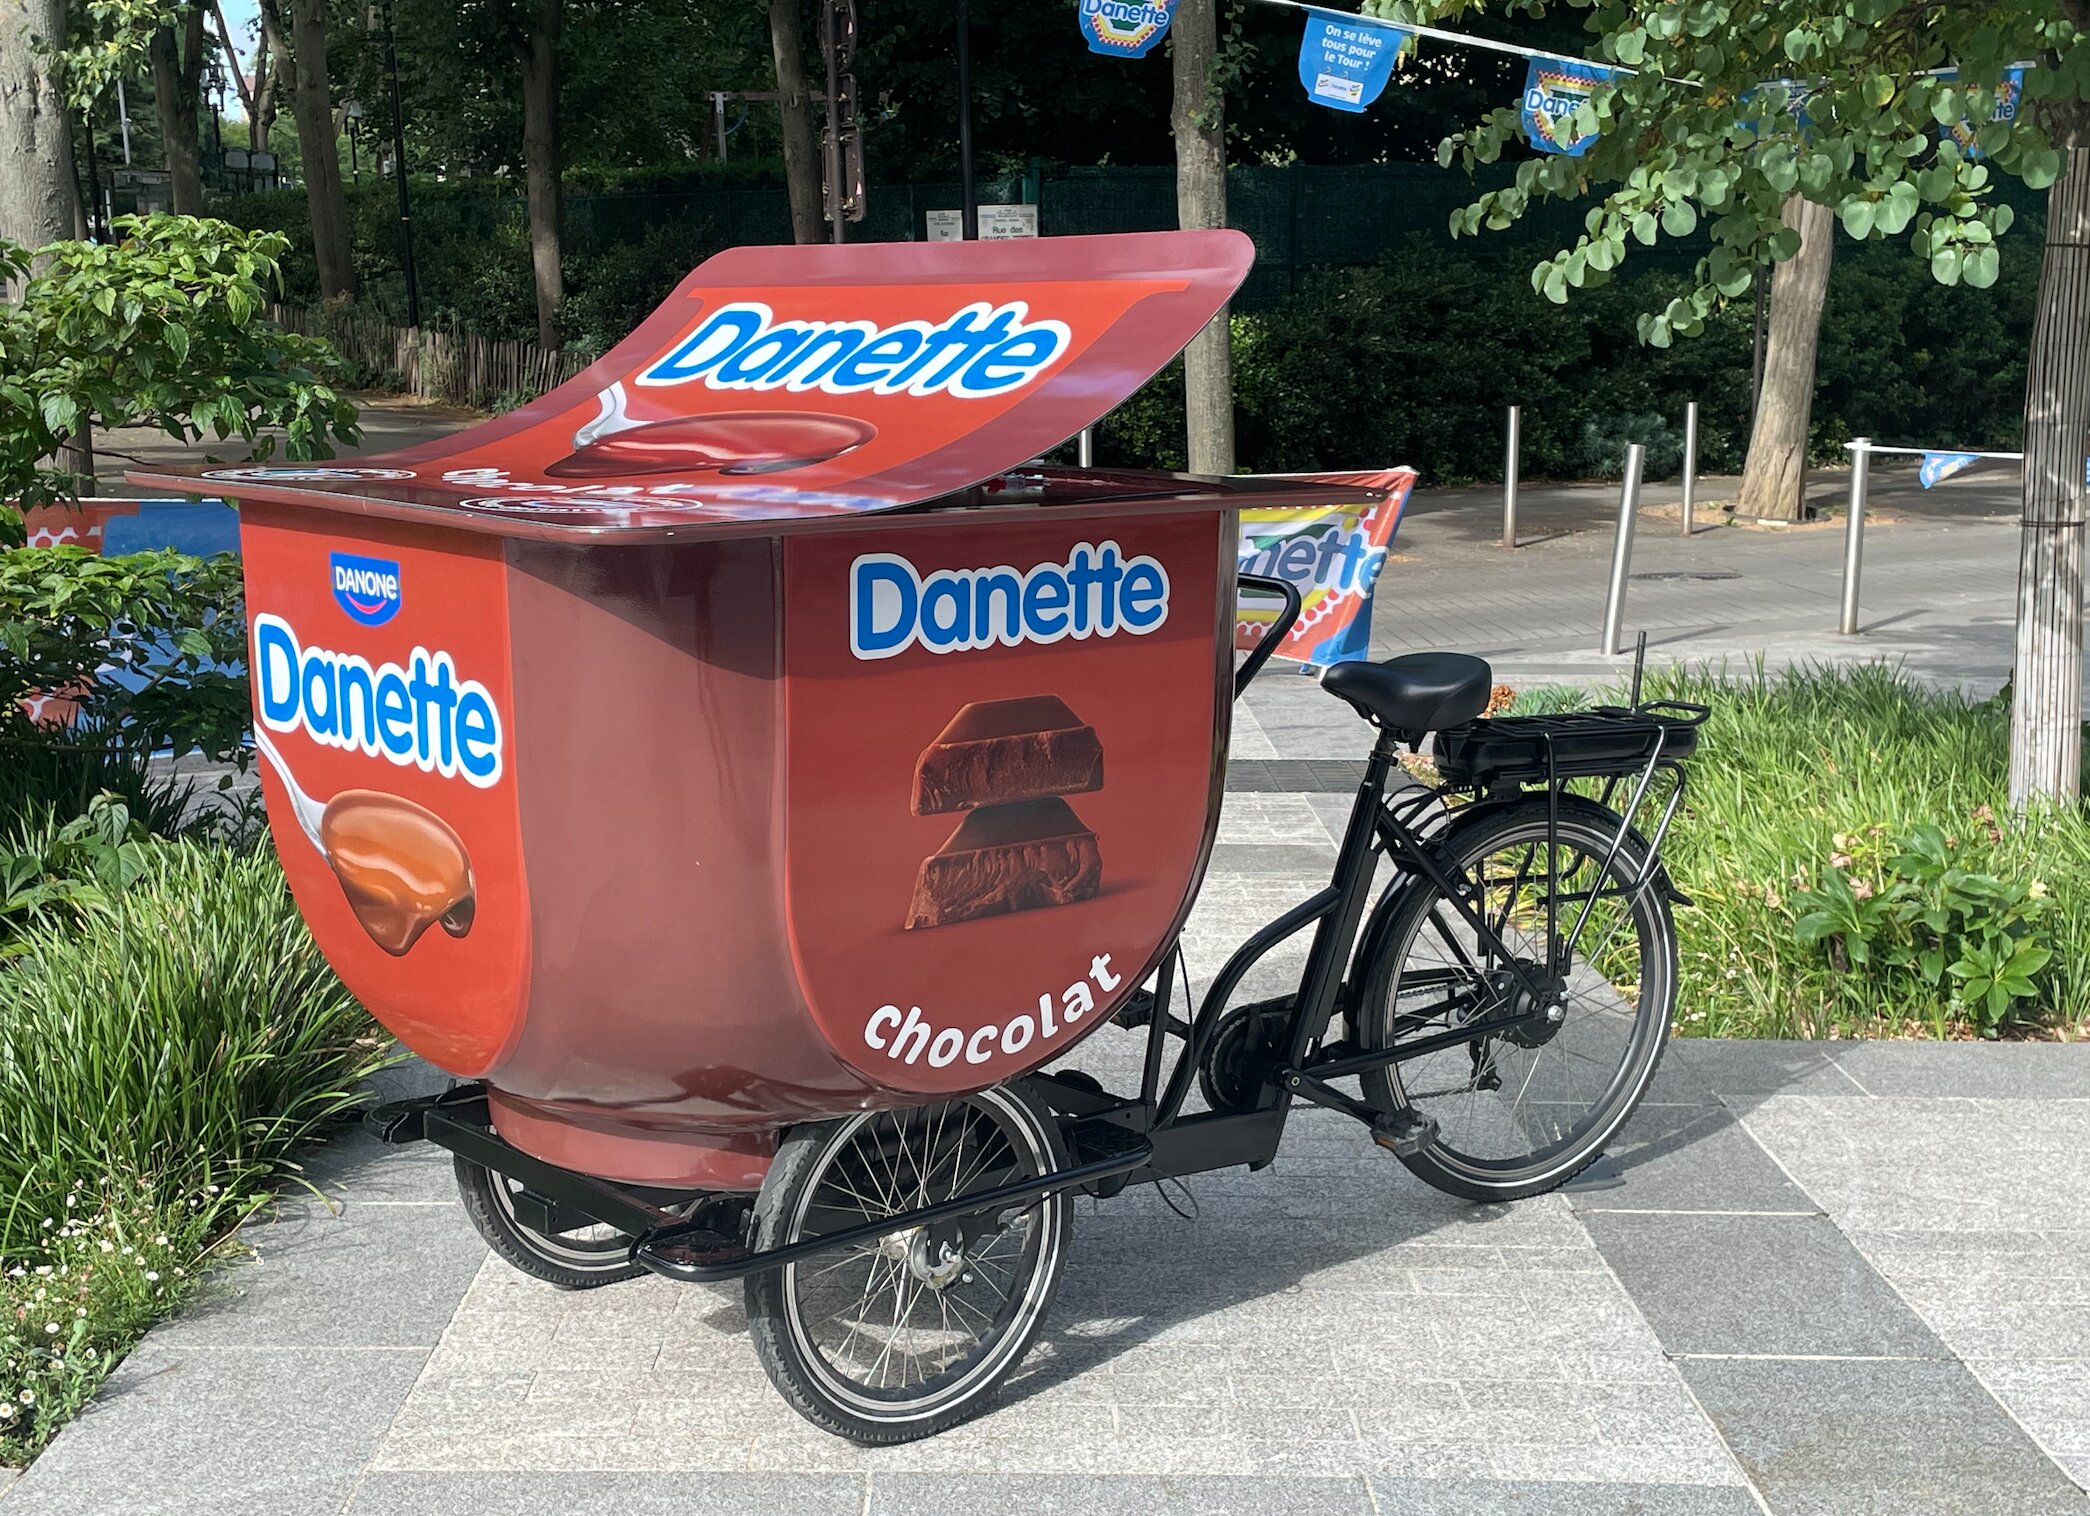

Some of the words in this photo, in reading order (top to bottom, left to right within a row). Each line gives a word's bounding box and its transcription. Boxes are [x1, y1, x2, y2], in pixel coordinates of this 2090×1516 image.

[1084, 0, 1168, 26] Danette
[1321, 37, 1348, 53] tous
[1348, 45, 1377, 59] pour
[1325, 25, 1342, 36] On
[1343, 30, 1357, 41] se
[1358, 32, 1383, 48] lève
[1324, 51, 1336, 63] le
[1337, 54, 1363, 69] Tour
[992, 226, 1007, 234] Rue
[642, 307, 1063, 394] Danette
[854, 545, 1167, 655] Danette
[256, 618, 500, 782] Danette
[864, 952, 1122, 1068] Chocolat
